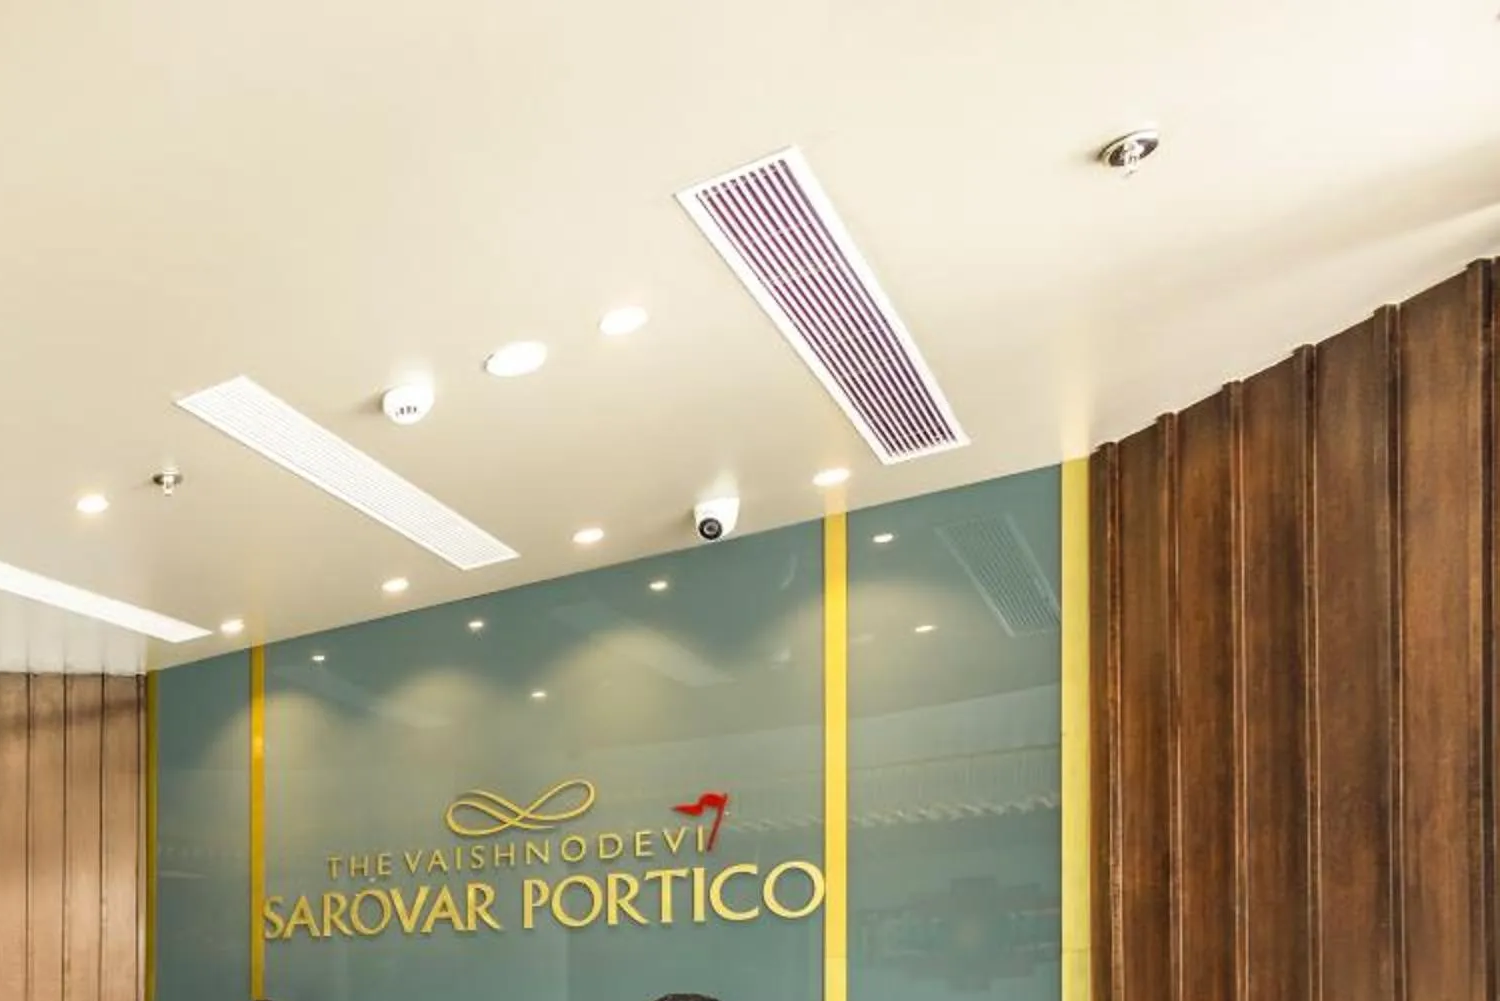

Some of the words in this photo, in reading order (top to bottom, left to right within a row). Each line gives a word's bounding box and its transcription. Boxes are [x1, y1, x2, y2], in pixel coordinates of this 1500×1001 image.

[327, 854, 393, 880] THE
[263, 880, 503, 940] SAROVAR
[522, 860, 827, 930] PORTICO
